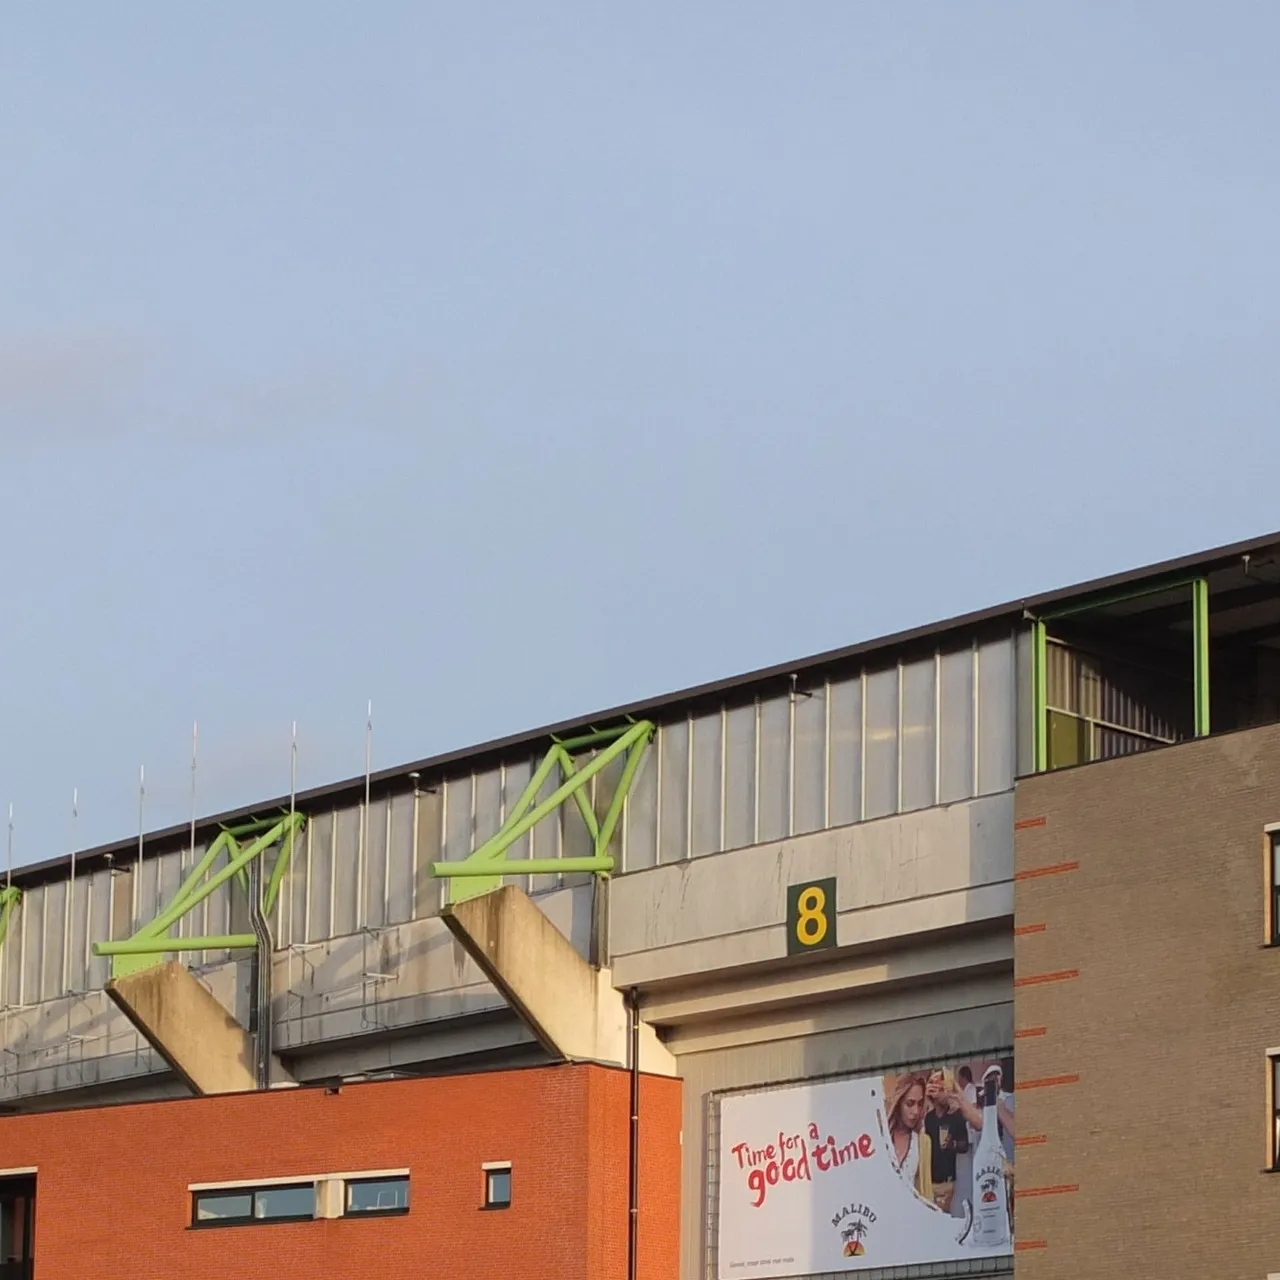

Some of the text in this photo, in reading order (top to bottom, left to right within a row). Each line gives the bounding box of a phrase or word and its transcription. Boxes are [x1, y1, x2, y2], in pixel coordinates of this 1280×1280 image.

[797, 886, 827, 945] 8
[731, 1122, 819, 1169] Time for a
[748, 1133, 876, 1208] good time
[831, 1203, 877, 1228] MALIBU
